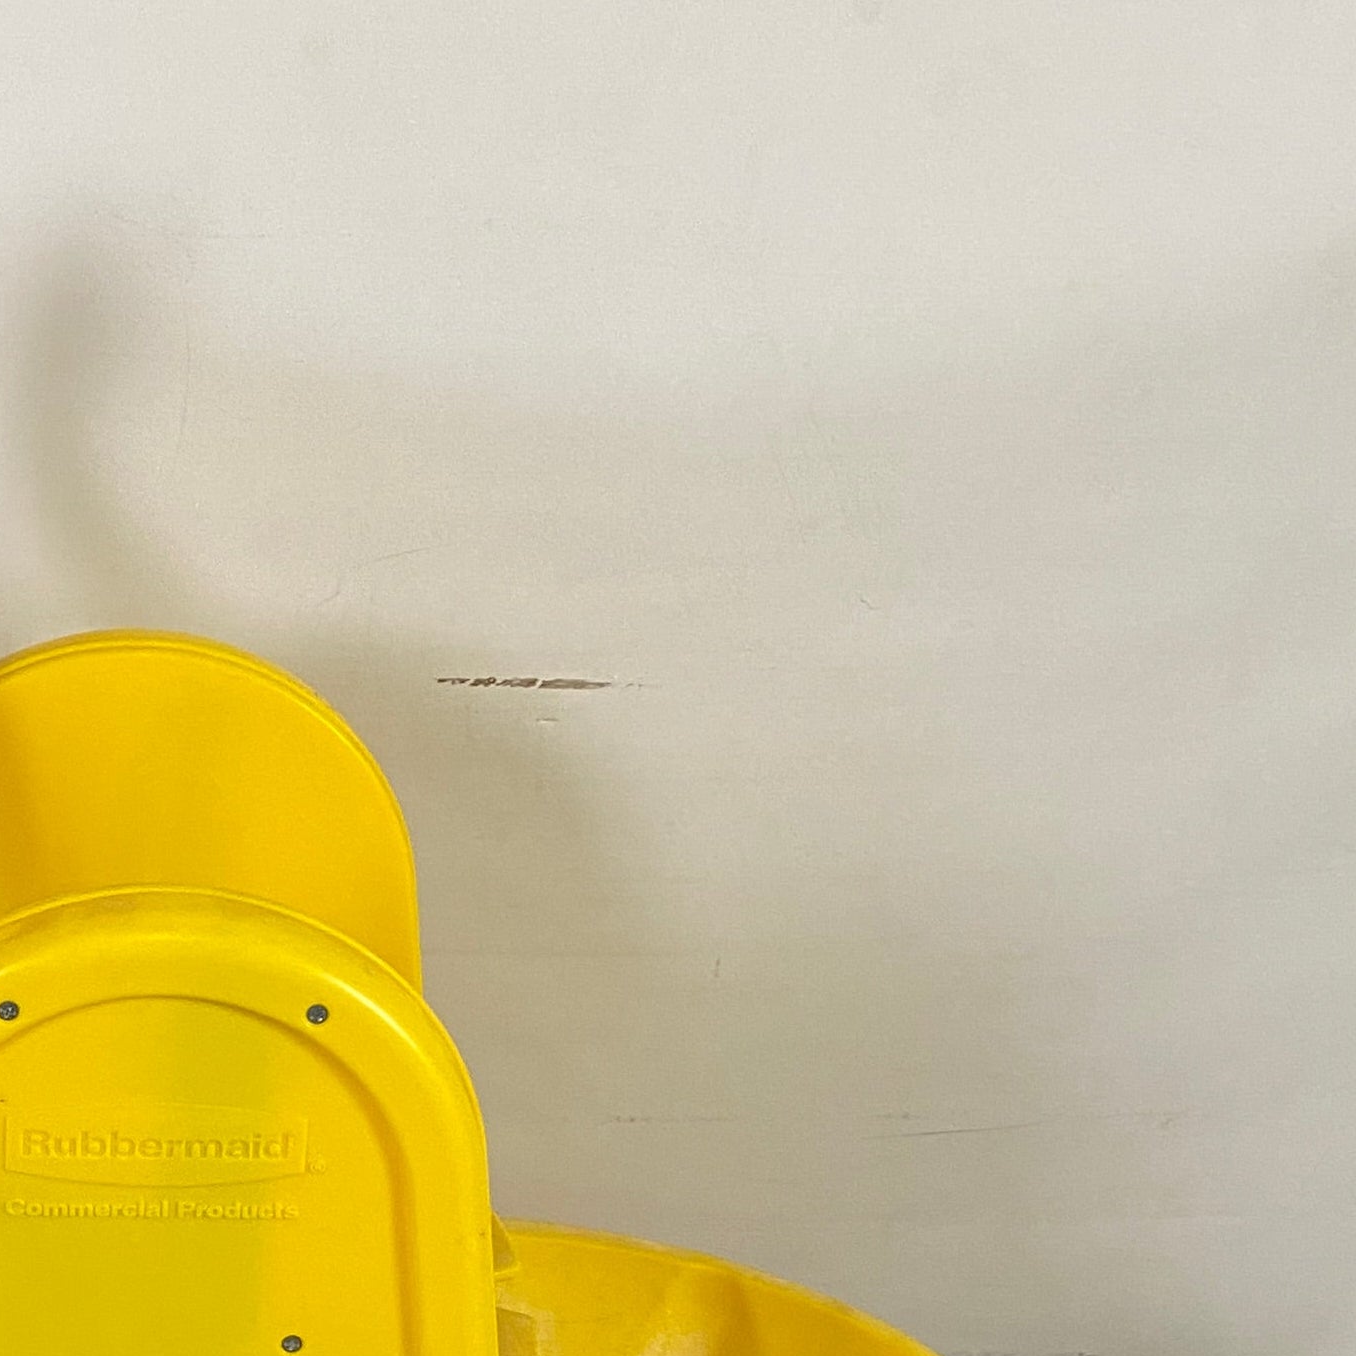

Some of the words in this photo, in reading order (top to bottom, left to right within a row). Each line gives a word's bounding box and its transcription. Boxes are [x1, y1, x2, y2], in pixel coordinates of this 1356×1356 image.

[20, 1129, 295, 1161] Rubbermaid
[5, 1198, 169, 1221] Commercial
[176, 1199, 301, 1222] Products
